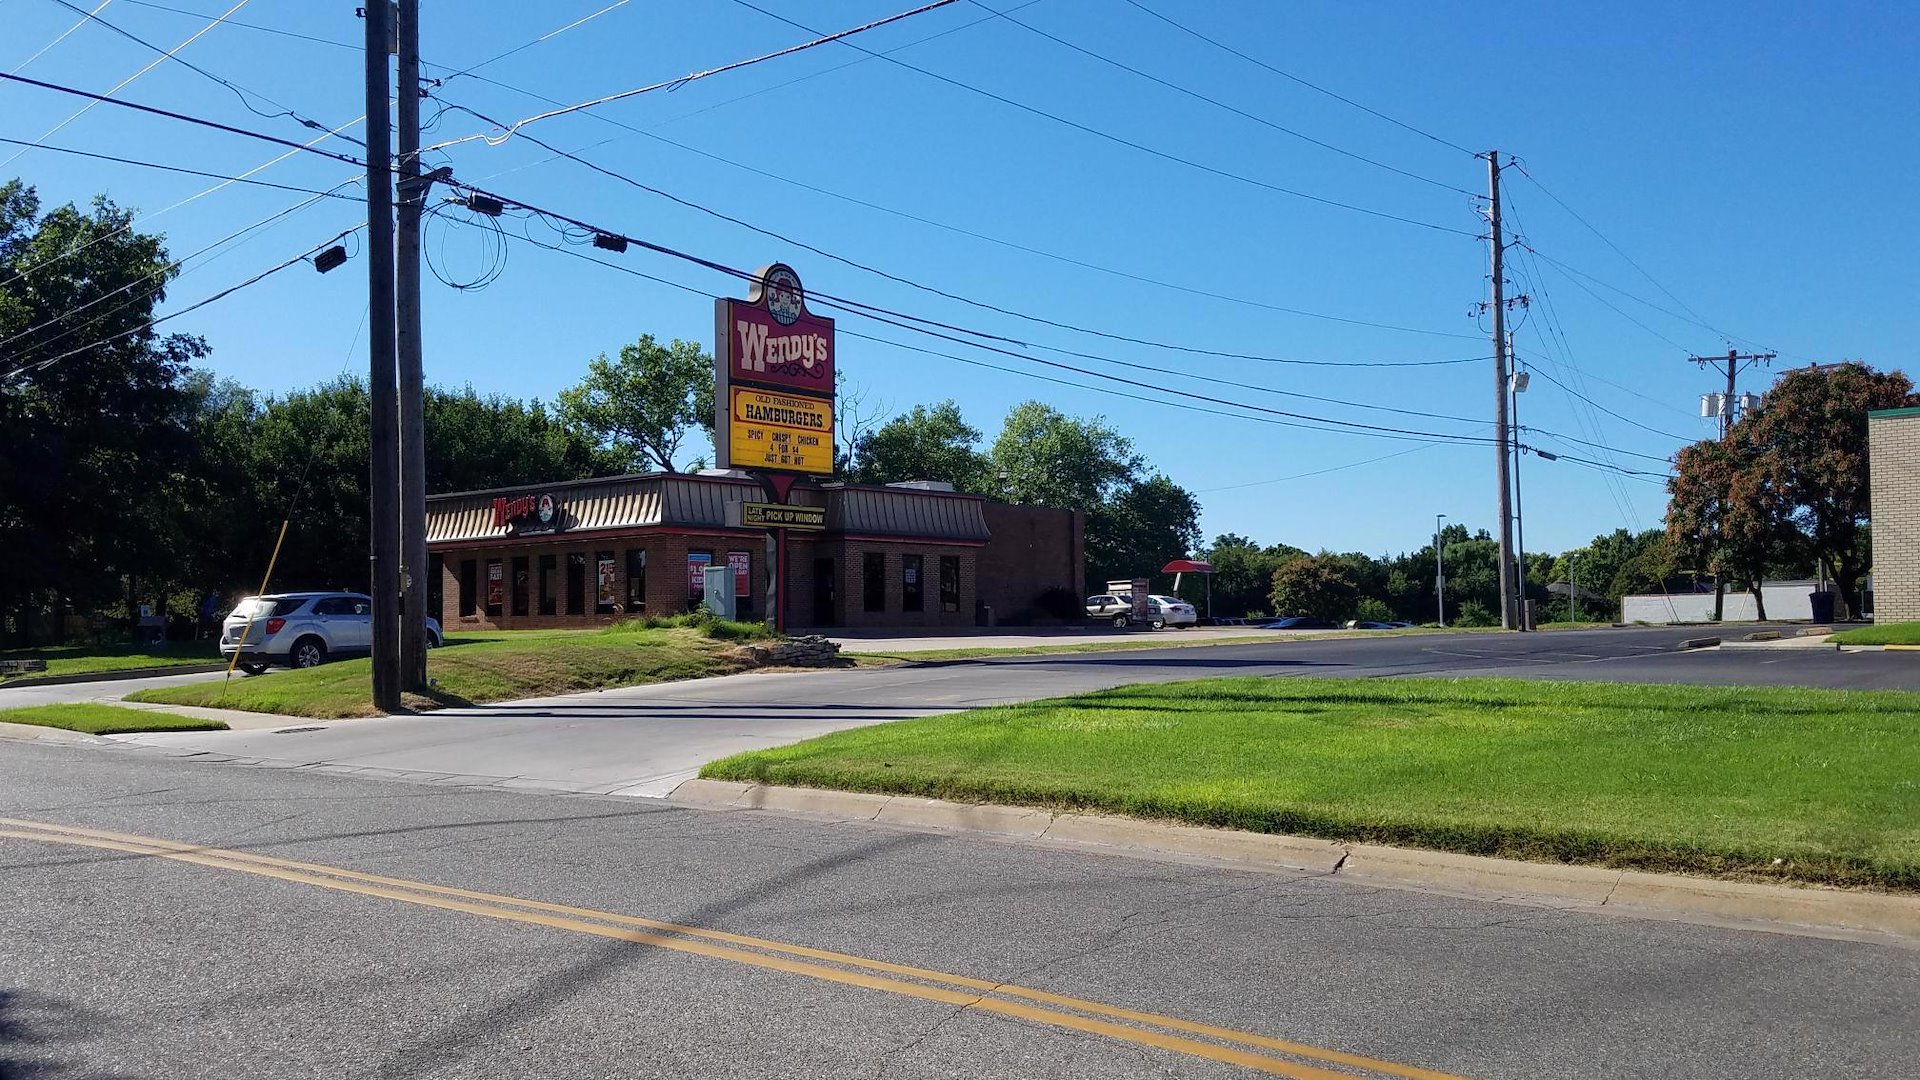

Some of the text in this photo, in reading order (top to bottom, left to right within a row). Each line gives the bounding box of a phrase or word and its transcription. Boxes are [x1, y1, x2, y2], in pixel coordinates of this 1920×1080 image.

[737, 320, 828, 372] Wendy's
[755, 395, 815, 410] OLD FASHIONED
[746, 404, 823, 428] HAMBURGERS
[748, 429, 764, 440] SPICY
[798, 435, 819, 446] CHICKEN
[770, 443, 774, 452] 4
[779, 444, 788, 454] FOR
[764, 453, 777, 463] JUST
[748, 507, 762, 515] LATE
[748, 514, 765, 522] NIGHT
[766, 511, 824, 524] PICK UP WINDOW
[690, 565, 704, 575] $1.9
